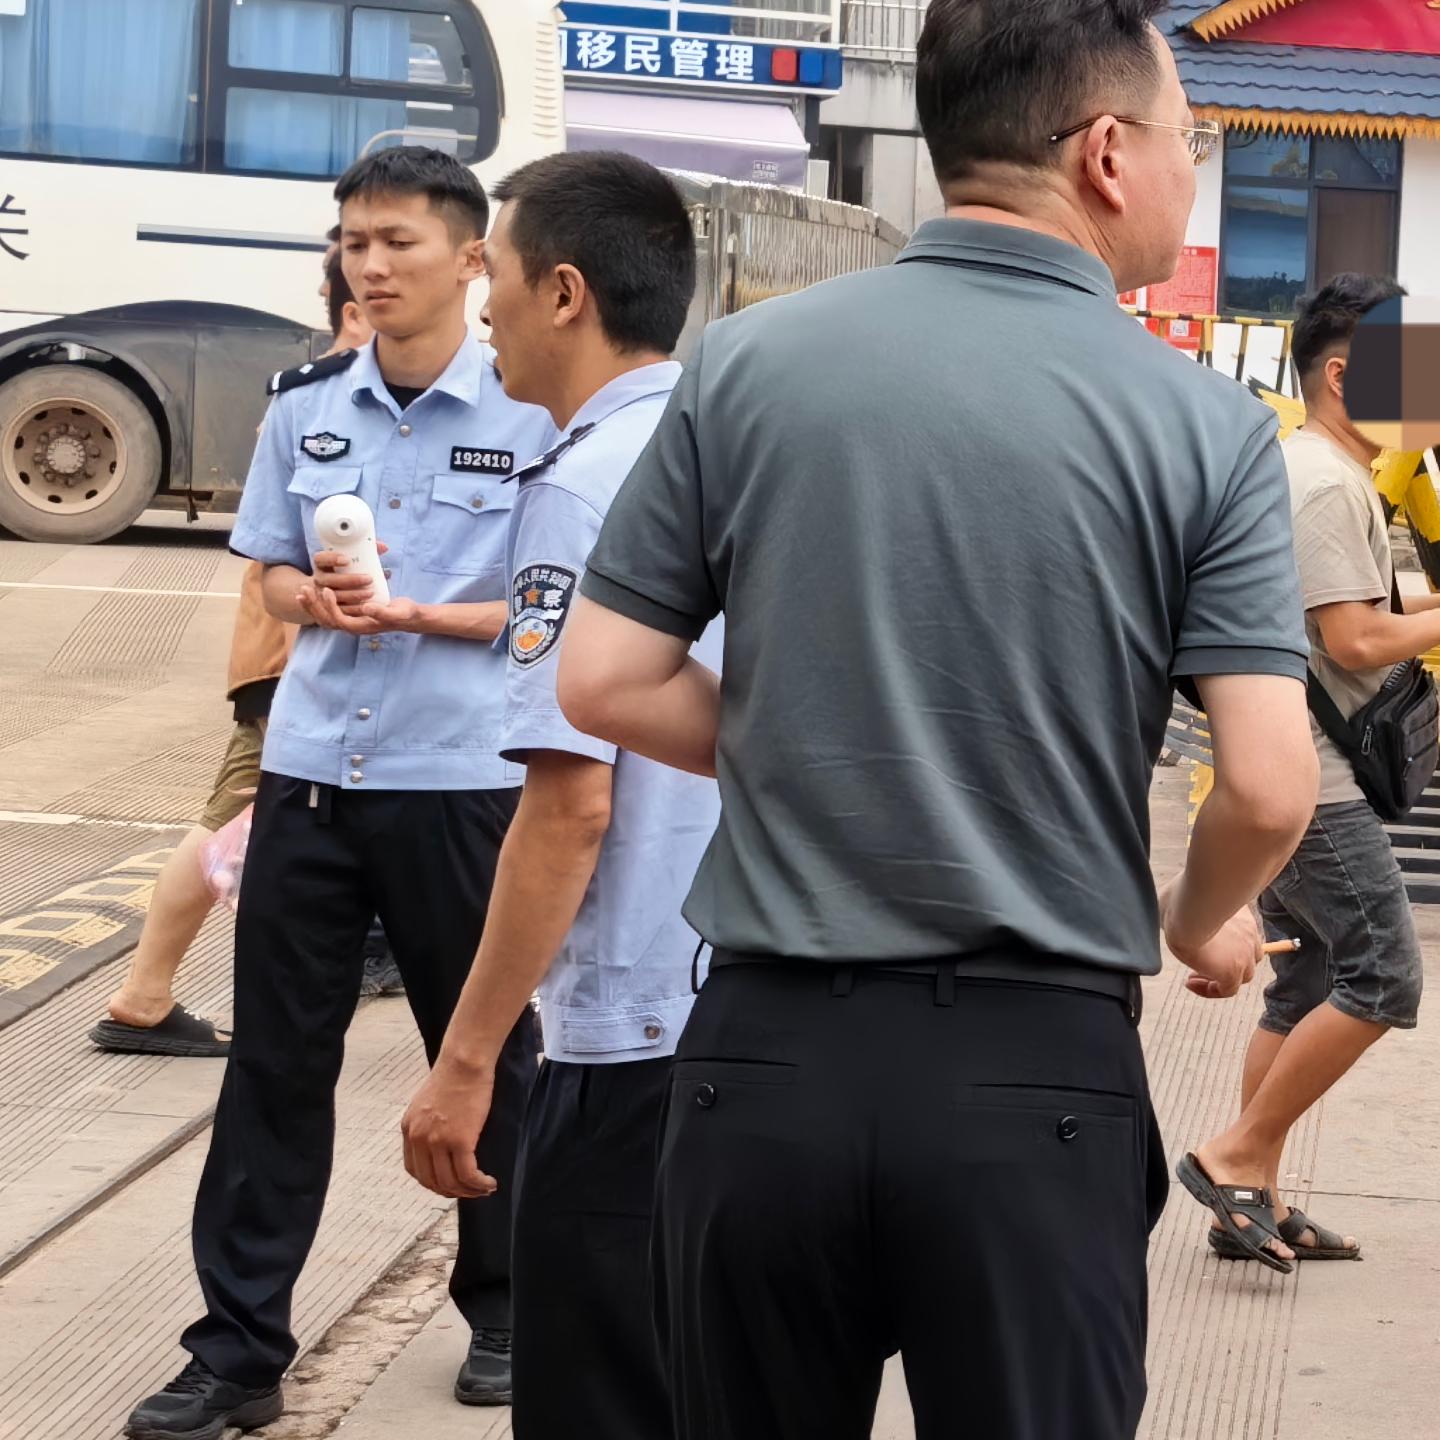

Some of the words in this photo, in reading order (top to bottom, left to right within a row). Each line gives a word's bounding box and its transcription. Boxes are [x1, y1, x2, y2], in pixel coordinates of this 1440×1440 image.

[559, 30, 755, 81] 移民管理
[453, 451, 511, 469] 192410
